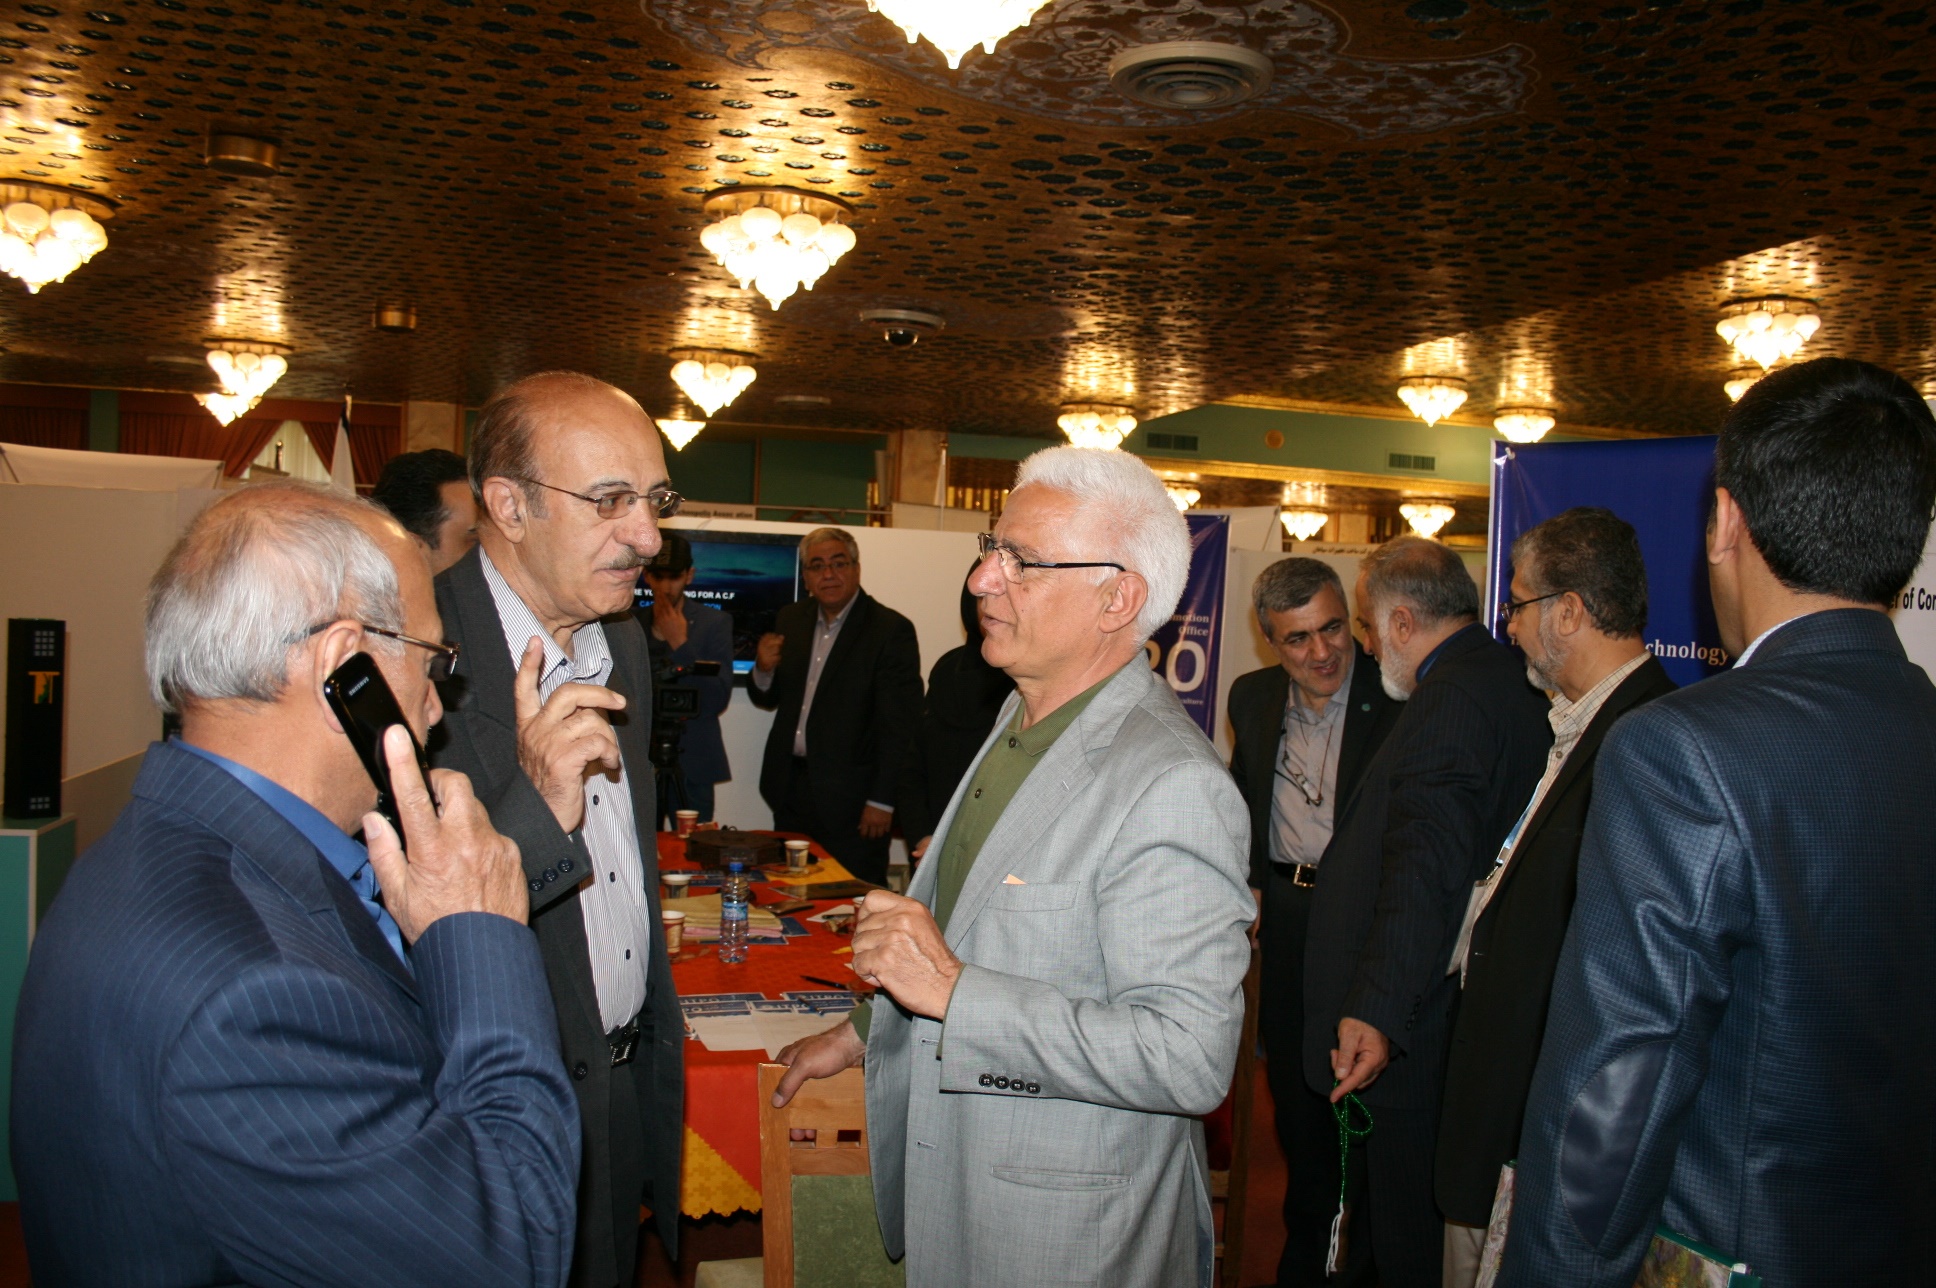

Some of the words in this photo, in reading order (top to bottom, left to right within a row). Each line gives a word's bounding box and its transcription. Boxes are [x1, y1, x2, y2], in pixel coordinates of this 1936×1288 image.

[697, 590, 714, 599] FOR
[715, 591, 722, 600] A
[1903, 587, 1915, 610] of
[1170, 613, 1210, 623] motion
[1178, 625, 1209, 636] Office
[1645, 639, 1729, 666] chnology
[348, 676, 370, 696] SAMSUNG
